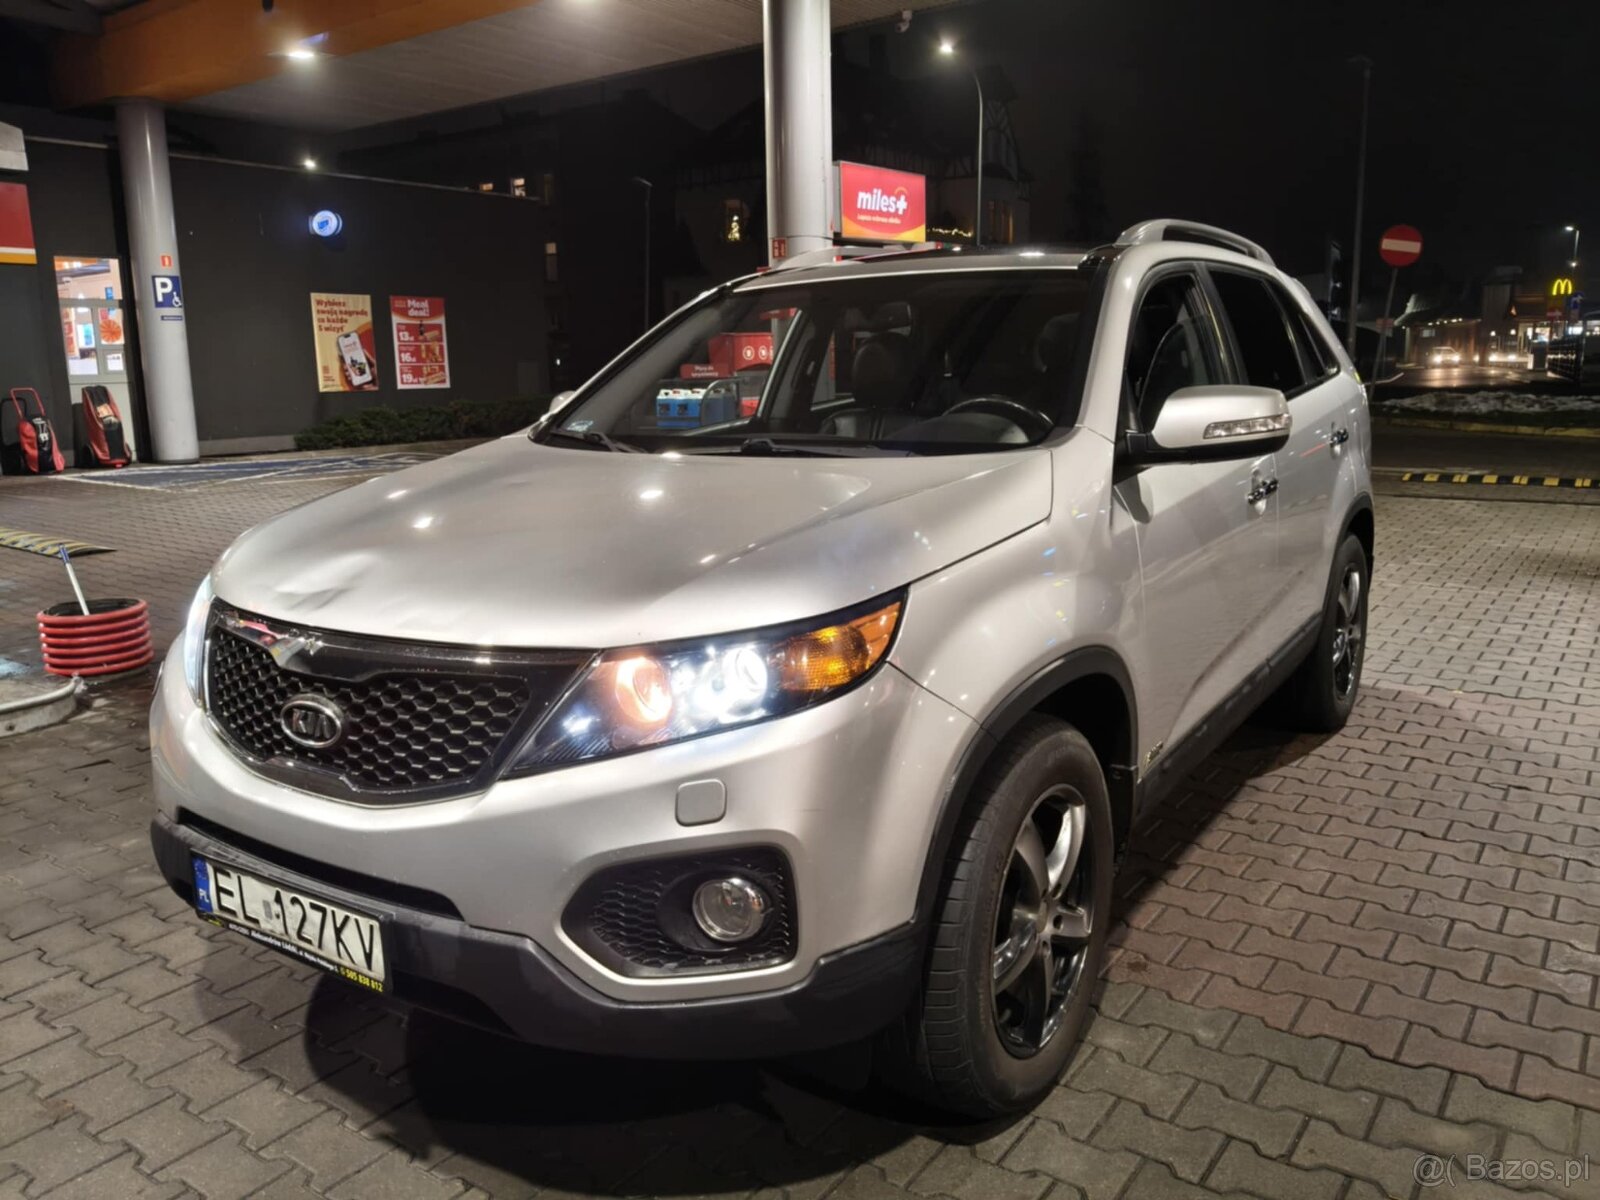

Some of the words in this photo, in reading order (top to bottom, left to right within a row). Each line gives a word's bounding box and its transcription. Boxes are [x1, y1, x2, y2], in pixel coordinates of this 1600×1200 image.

[857, 188, 907, 215] miles+
[155, 277, 173, 302] P
[315, 299, 345, 308] Wybierz
[339, 309, 368, 317] nagrodę
[407, 299, 428, 309] Meal
[293, 708, 331, 739] KIA
[199, 888, 210, 903] PL
[213, 867, 260, 924] EL
[274, 889, 374, 972] 127KV
